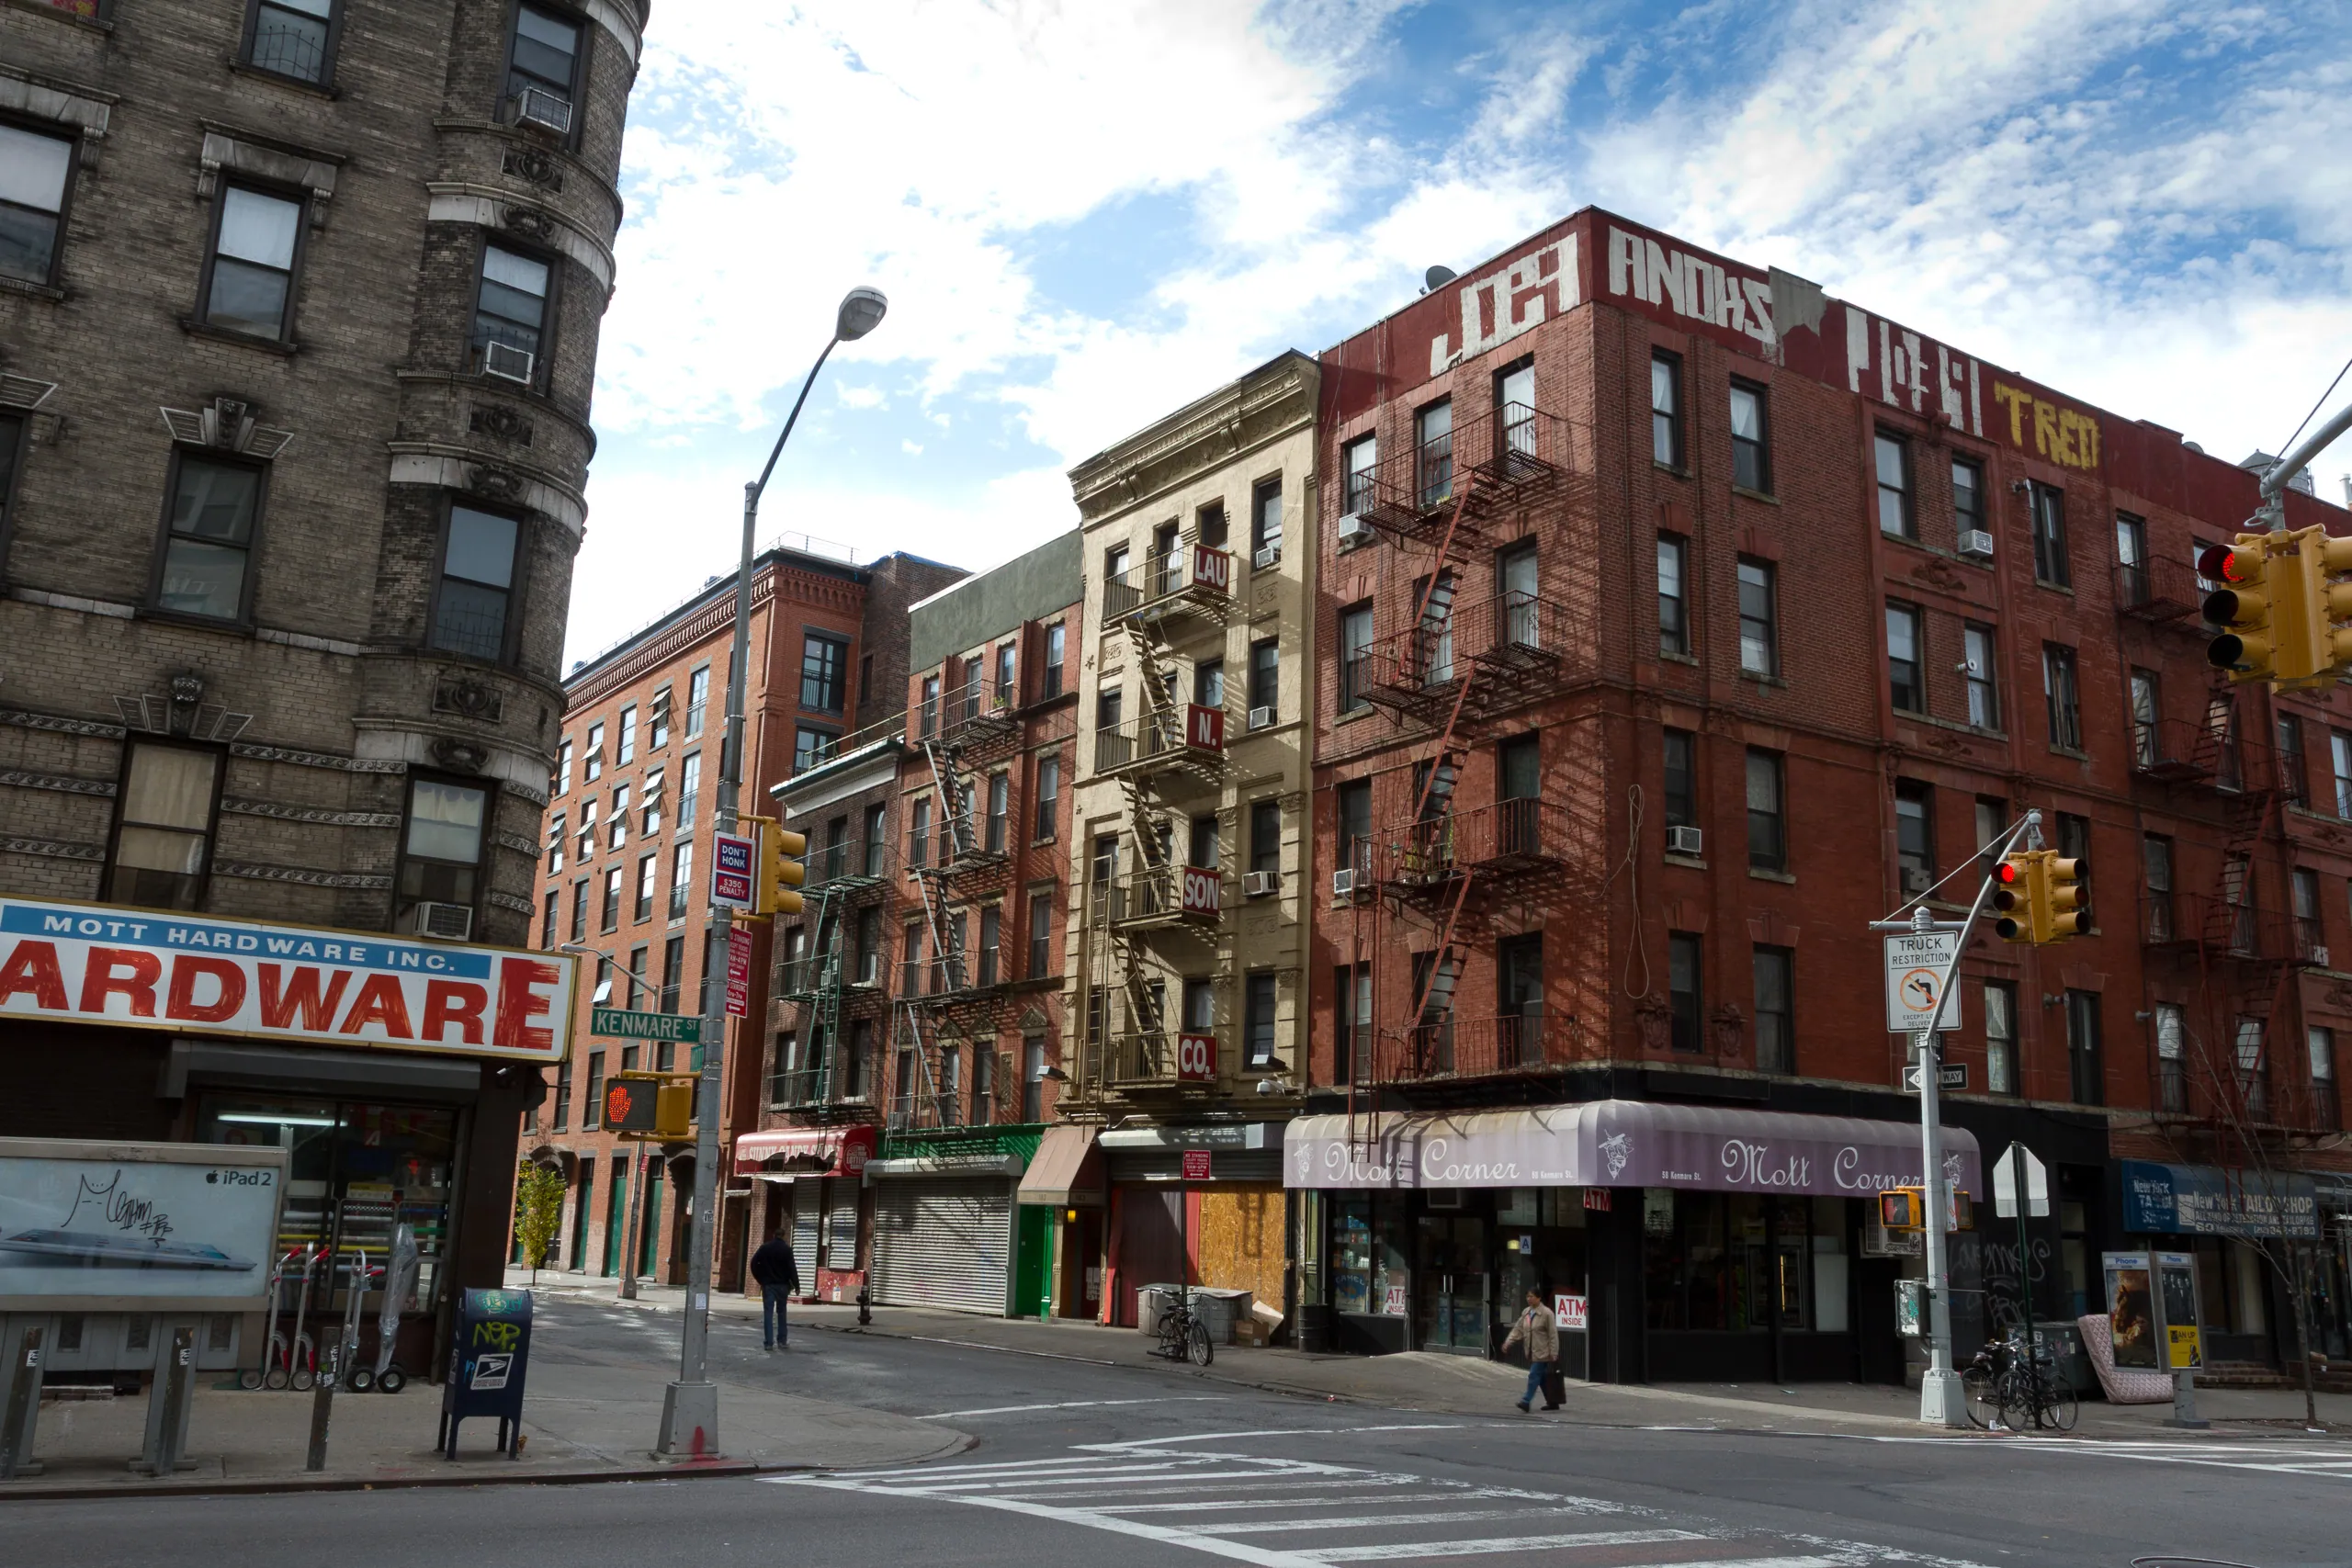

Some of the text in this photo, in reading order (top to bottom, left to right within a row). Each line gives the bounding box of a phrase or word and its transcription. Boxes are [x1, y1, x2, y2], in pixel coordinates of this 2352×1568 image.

[1195, 549, 1227, 587] LAU
[1197, 711, 1217, 747] N.
[722, 844, 746, 858] DON'T
[721, 855, 745, 868] HONK
[718, 885, 745, 897] PENALTY
[723, 878, 742, 888] $350
[1183, 872, 1219, 910] SON
[44, 915, 455, 971] MOTT HARDWARE INC.
[1899, 937, 1942, 951] TRUCK
[1892, 952, 1951, 965] RESTRICTION
[596, 1011, 698, 1039] KENMARE ST
[1180, 1038, 1210, 1074] CO.
[1942, 1072, 1961, 1082] WAY
[1324, 1141, 1405, 1182] Mott
[1420, 1138, 1520, 1181] Corner
[1540, 1170, 1564, 1179] Kenmare
[1670, 1170, 1692, 1181] Kenmare
[1721, 1138, 1812, 1187] Mott
[1833, 1145, 1923, 1190] Corner
[222, 1170, 272, 1186] iPad 2
[1584, 1189, 1611, 1212] ATM
[2193, 1190, 2213, 1209] New
[2215, 1192, 2237, 1212] York
[1521, 1237, 1530, 1249] A
[2166, 1255, 2182, 1263] Phone
[1334, 1274, 1365, 1285] CAMEL
[1557, 1298, 1587, 1316] ATM
[1561, 1317, 1582, 1325] INSIDE
